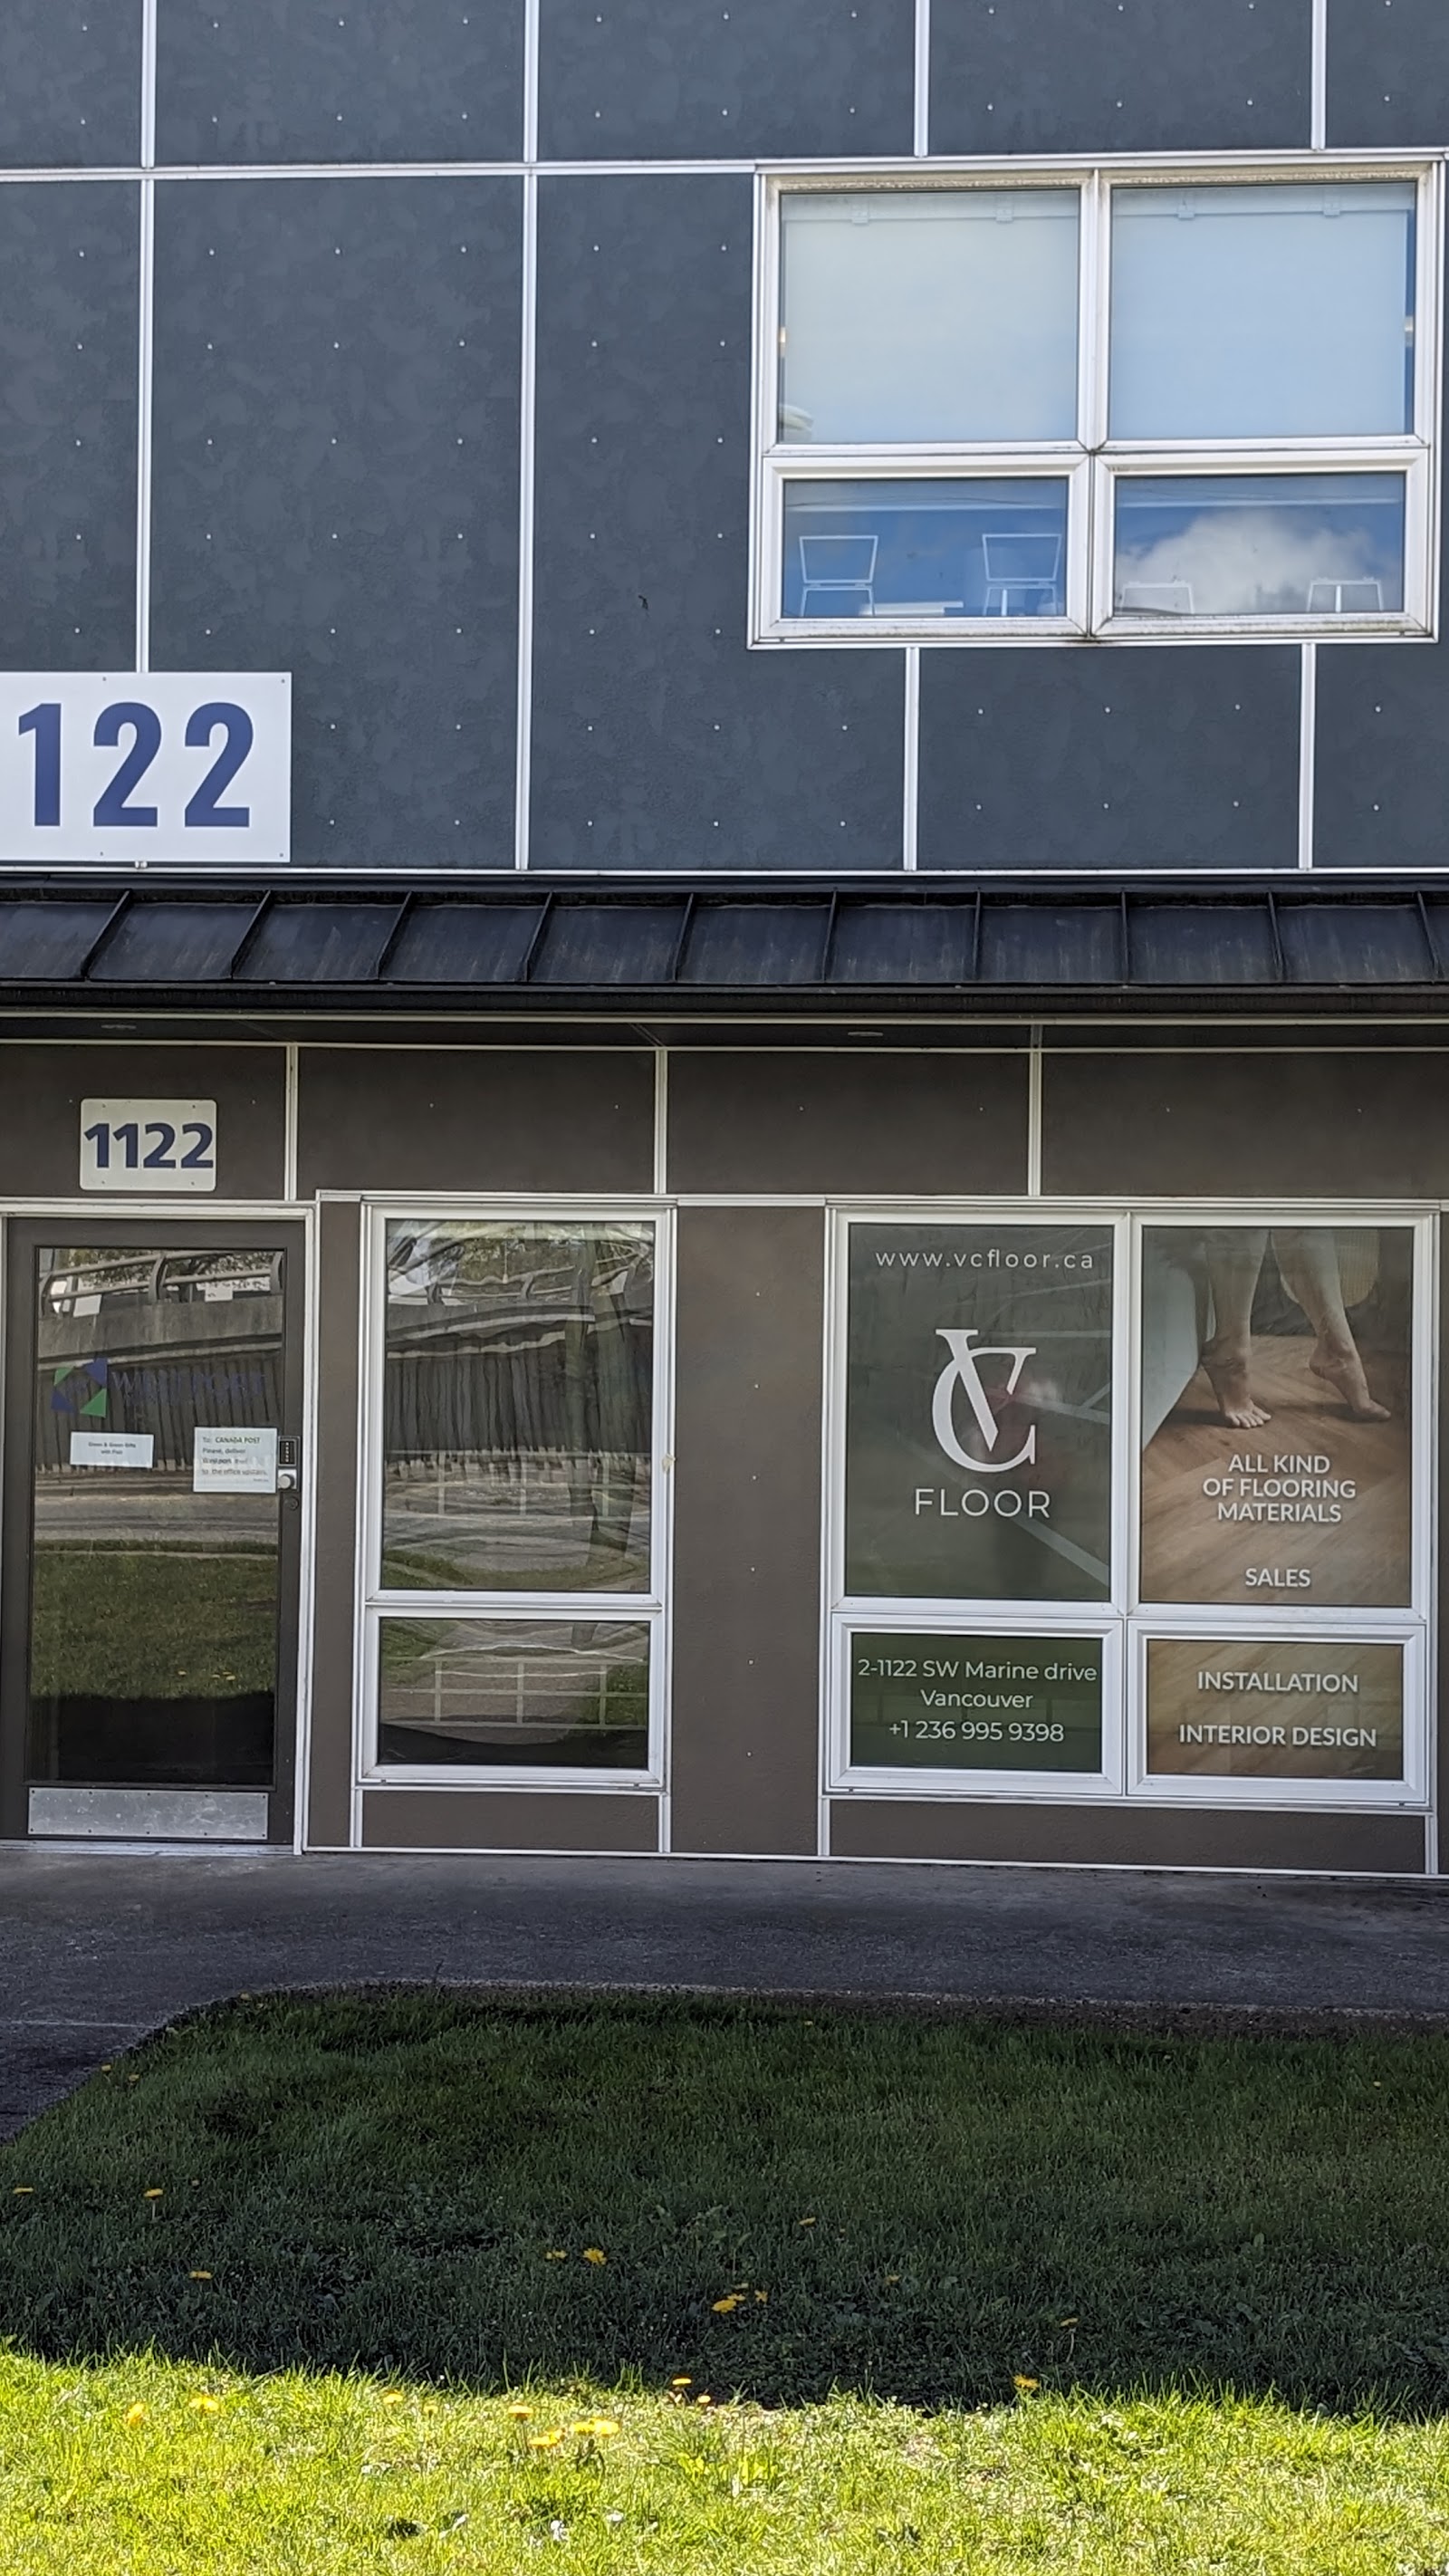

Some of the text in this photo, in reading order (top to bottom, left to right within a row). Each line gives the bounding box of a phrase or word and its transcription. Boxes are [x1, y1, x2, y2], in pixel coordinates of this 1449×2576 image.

[18, 702, 254, 828] 122
[84, 1122, 214, 1168] 1122
[875, 1249, 1093, 1269] www.vcfloor.ca
[215, 1436, 243, 1445] CANADA
[244, 1436, 261, 1445] POST
[1227, 1454, 1331, 1475] ALL KIND
[1202, 1477, 1358, 1499] OF FLOORING
[915, 1488, 1051, 1519] FLOOR
[1217, 1502, 1342, 1523] MATERIALS
[1245, 1568, 1311, 1588] SALES
[858, 1658, 1098, 1682] 2-1122 SW Marine drive
[1196, 1671, 1358, 1693] INSTALLATION
[920, 1689, 1033, 1709] Vancouver
[888, 1720, 1065, 1743] +1 236 995 9398
[1179, 1724, 1377, 1747] INTERIOR DESIGN
